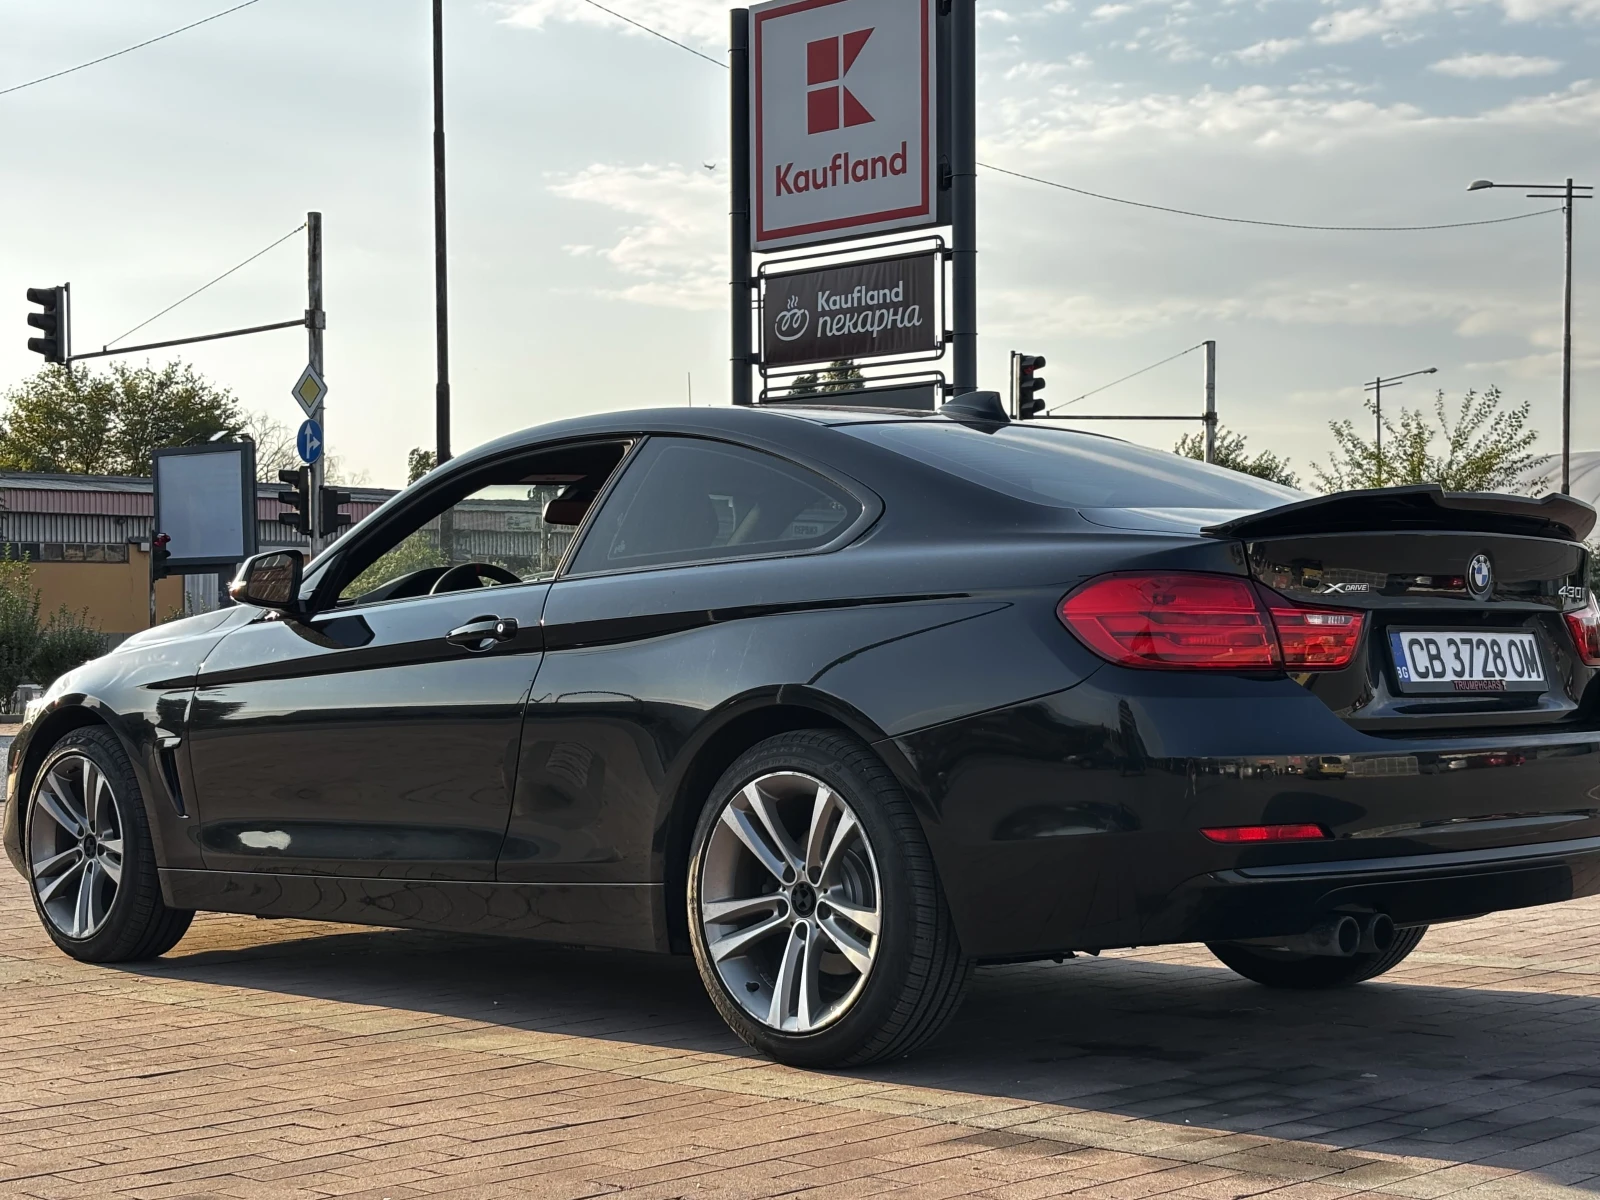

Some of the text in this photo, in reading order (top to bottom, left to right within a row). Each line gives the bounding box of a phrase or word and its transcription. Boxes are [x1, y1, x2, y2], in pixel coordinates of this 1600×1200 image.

[775, 141, 907, 196] Kaufland
[817, 281, 904, 312] Kaufland
[816, 304, 923, 338] пекарна
[1408, 637, 1541, 679] CB 3728 OM
